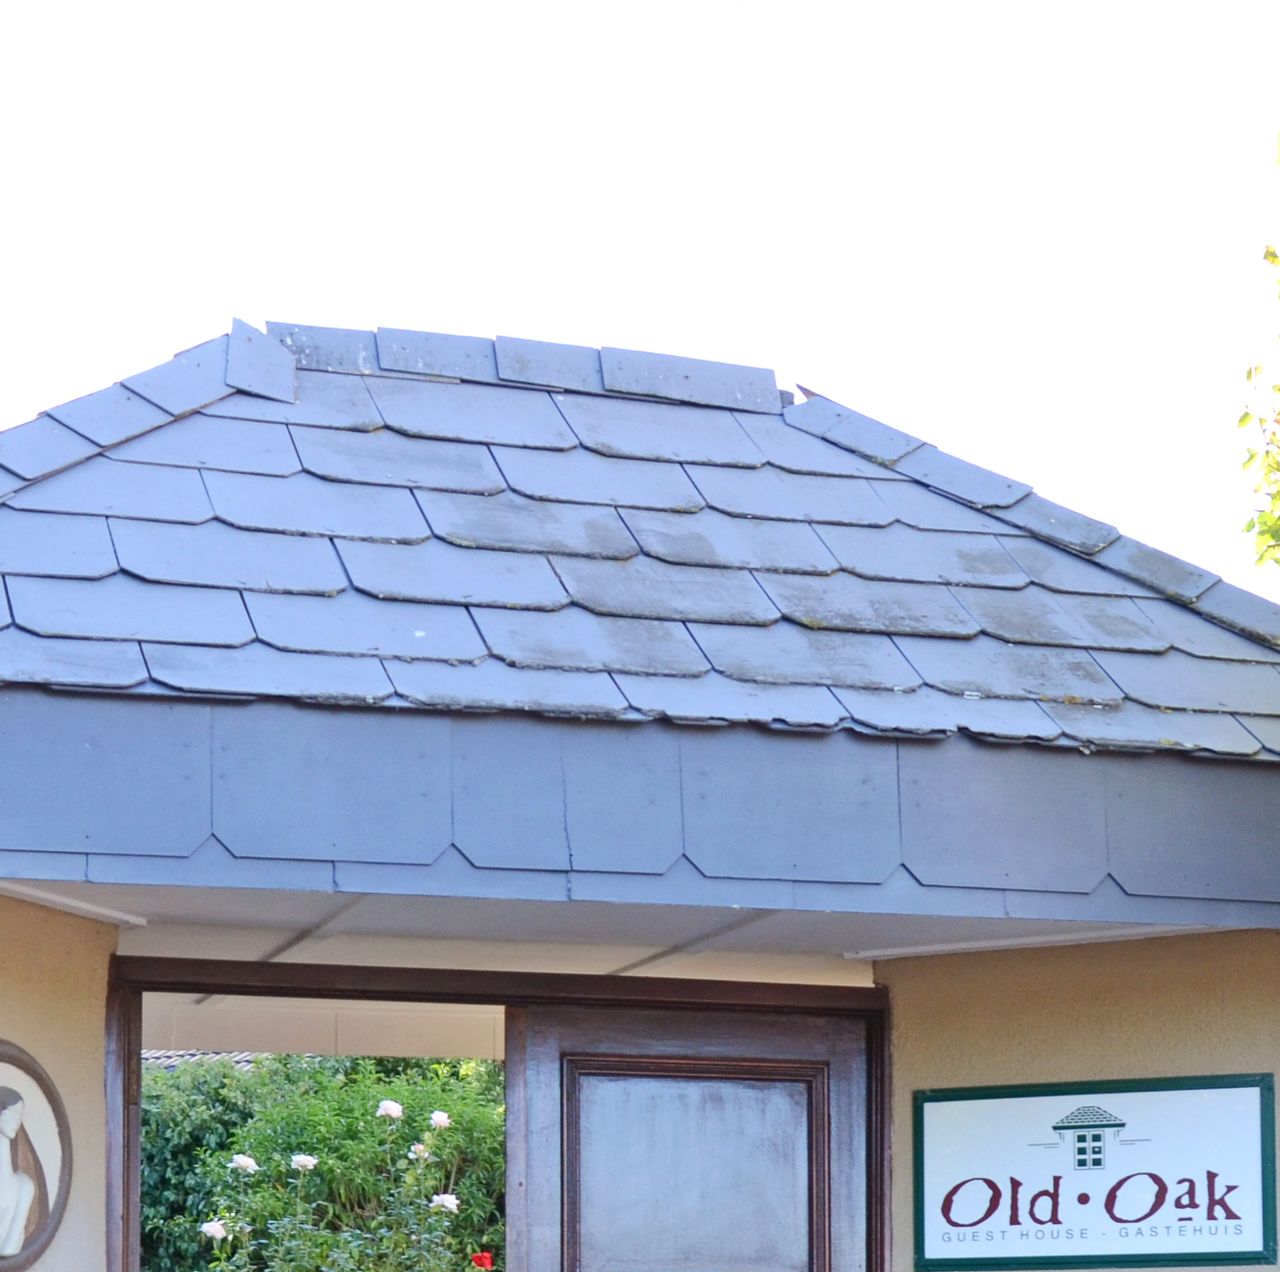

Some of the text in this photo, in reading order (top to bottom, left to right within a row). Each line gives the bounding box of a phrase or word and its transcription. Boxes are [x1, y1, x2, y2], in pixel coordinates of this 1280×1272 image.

[940, 1169, 1243, 1228] Old Oak
[941, 1223, 1244, 1243] GUEST HOUSE GASTEHUIS
